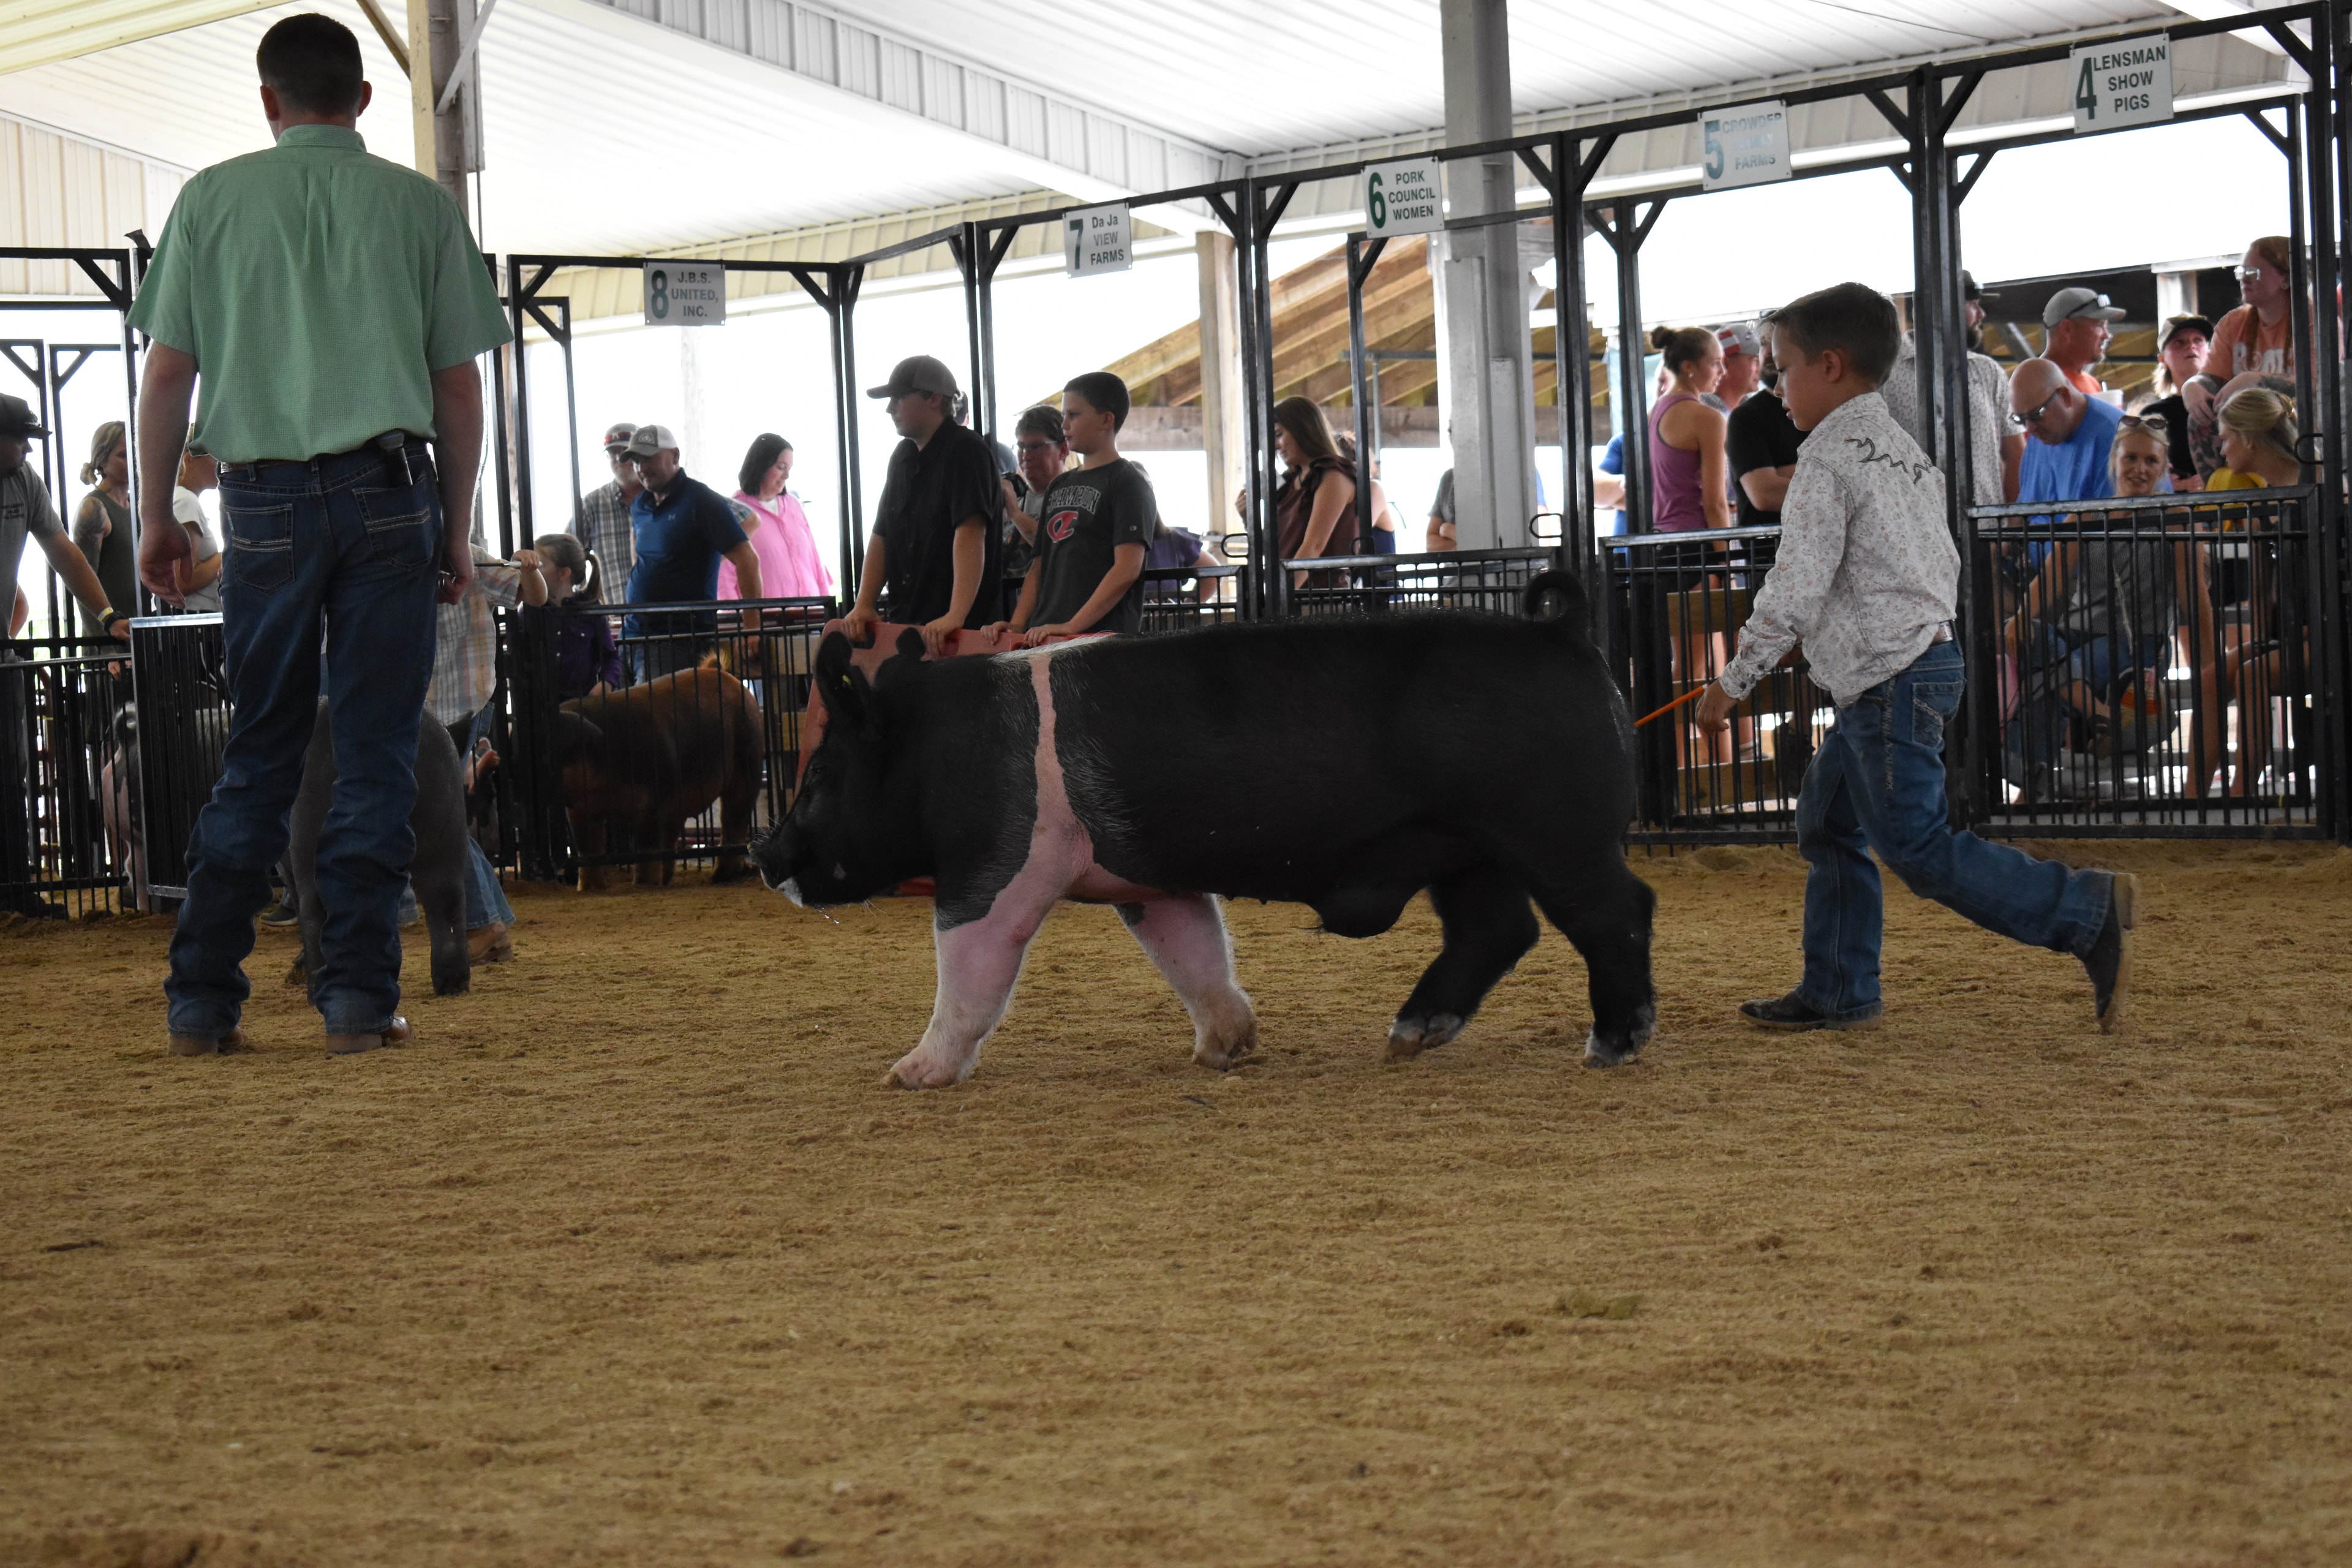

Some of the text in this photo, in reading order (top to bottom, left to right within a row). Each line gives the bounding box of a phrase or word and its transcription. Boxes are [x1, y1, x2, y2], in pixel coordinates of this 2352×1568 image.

[2094, 45, 2166, 71] LENSMAN
[2076, 58, 2097, 120] 4
[2108, 70, 2154, 92] SHOW
[2114, 94, 2150, 113] PIGS
[1705, 119, 1724, 180] 5
[1735, 154, 1776, 170] FARMS
[1396, 170, 1425, 185] PORK
[1368, 172, 1386, 229] 6
[1388, 187, 1436, 203] COUNCIL
[1393, 205, 1434, 221] WOMEN
[1091, 214, 1118, 229] Da Ja
[1069, 218, 1084, 270] 7
[1093, 232, 1118, 246] VIEW
[1090, 249, 1124, 266] FARMS
[677, 271, 712, 284] J.B.S.
[650, 270, 669, 319] 8
[671, 288, 718, 303] UNITED,
[683, 305, 708, 317] INC.
